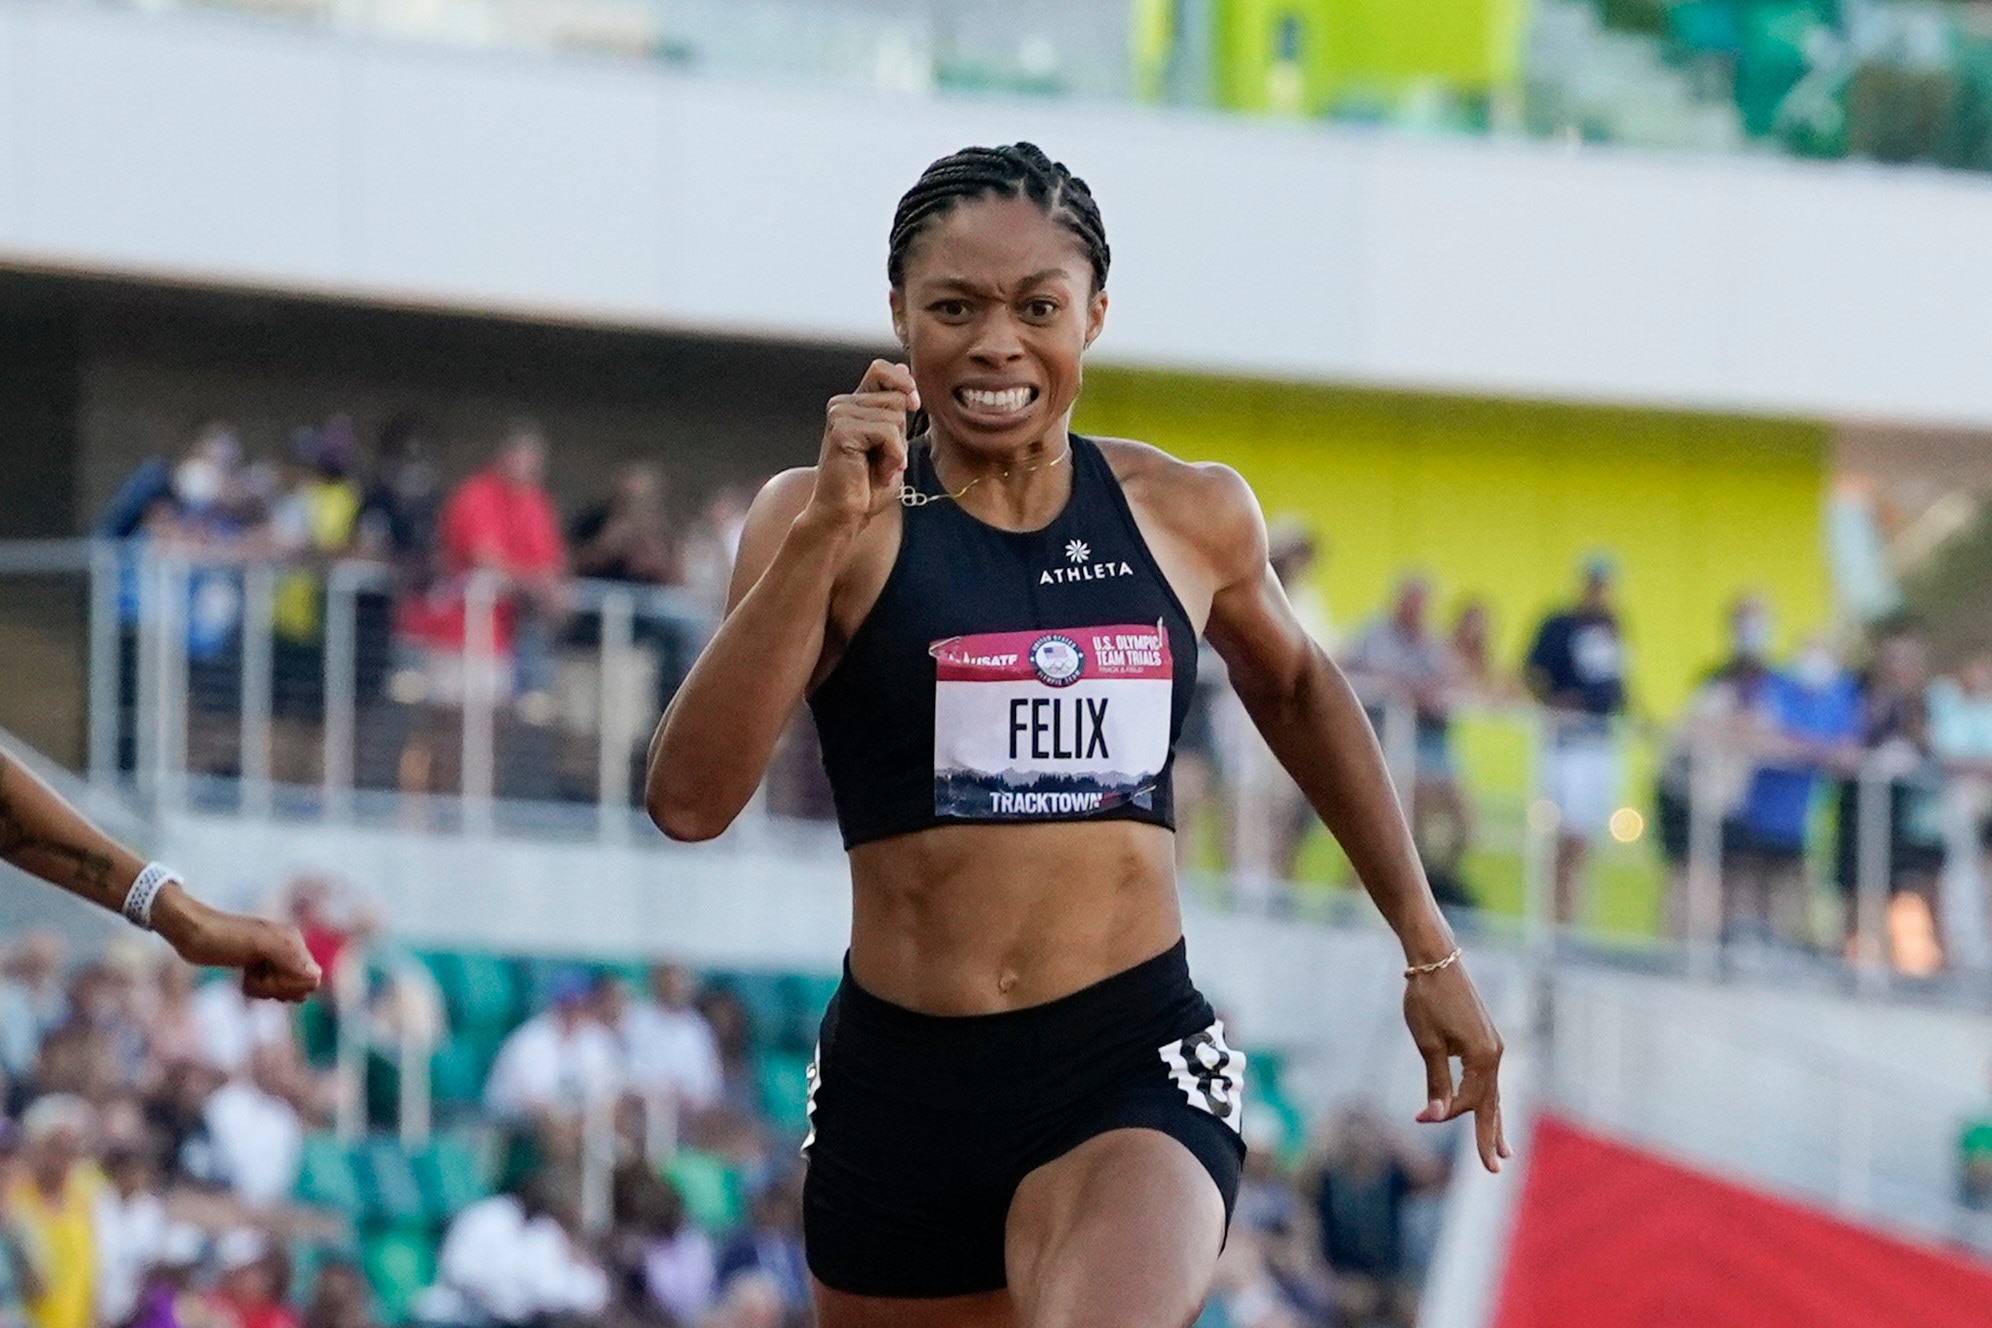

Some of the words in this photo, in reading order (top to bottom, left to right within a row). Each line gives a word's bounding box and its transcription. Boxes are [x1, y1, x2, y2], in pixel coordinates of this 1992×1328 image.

[1040, 561, 1134, 585] ATHLETA
[1092, 635, 1115, 651] U.S.
[1115, 634, 1160, 650] OLYMPIC
[1096, 650, 1125, 666] TEAM
[1126, 650, 1162, 666] TRIALS
[1009, 698, 1109, 759] FELIX
[989, 792, 1103, 814] TRACKTOWN
